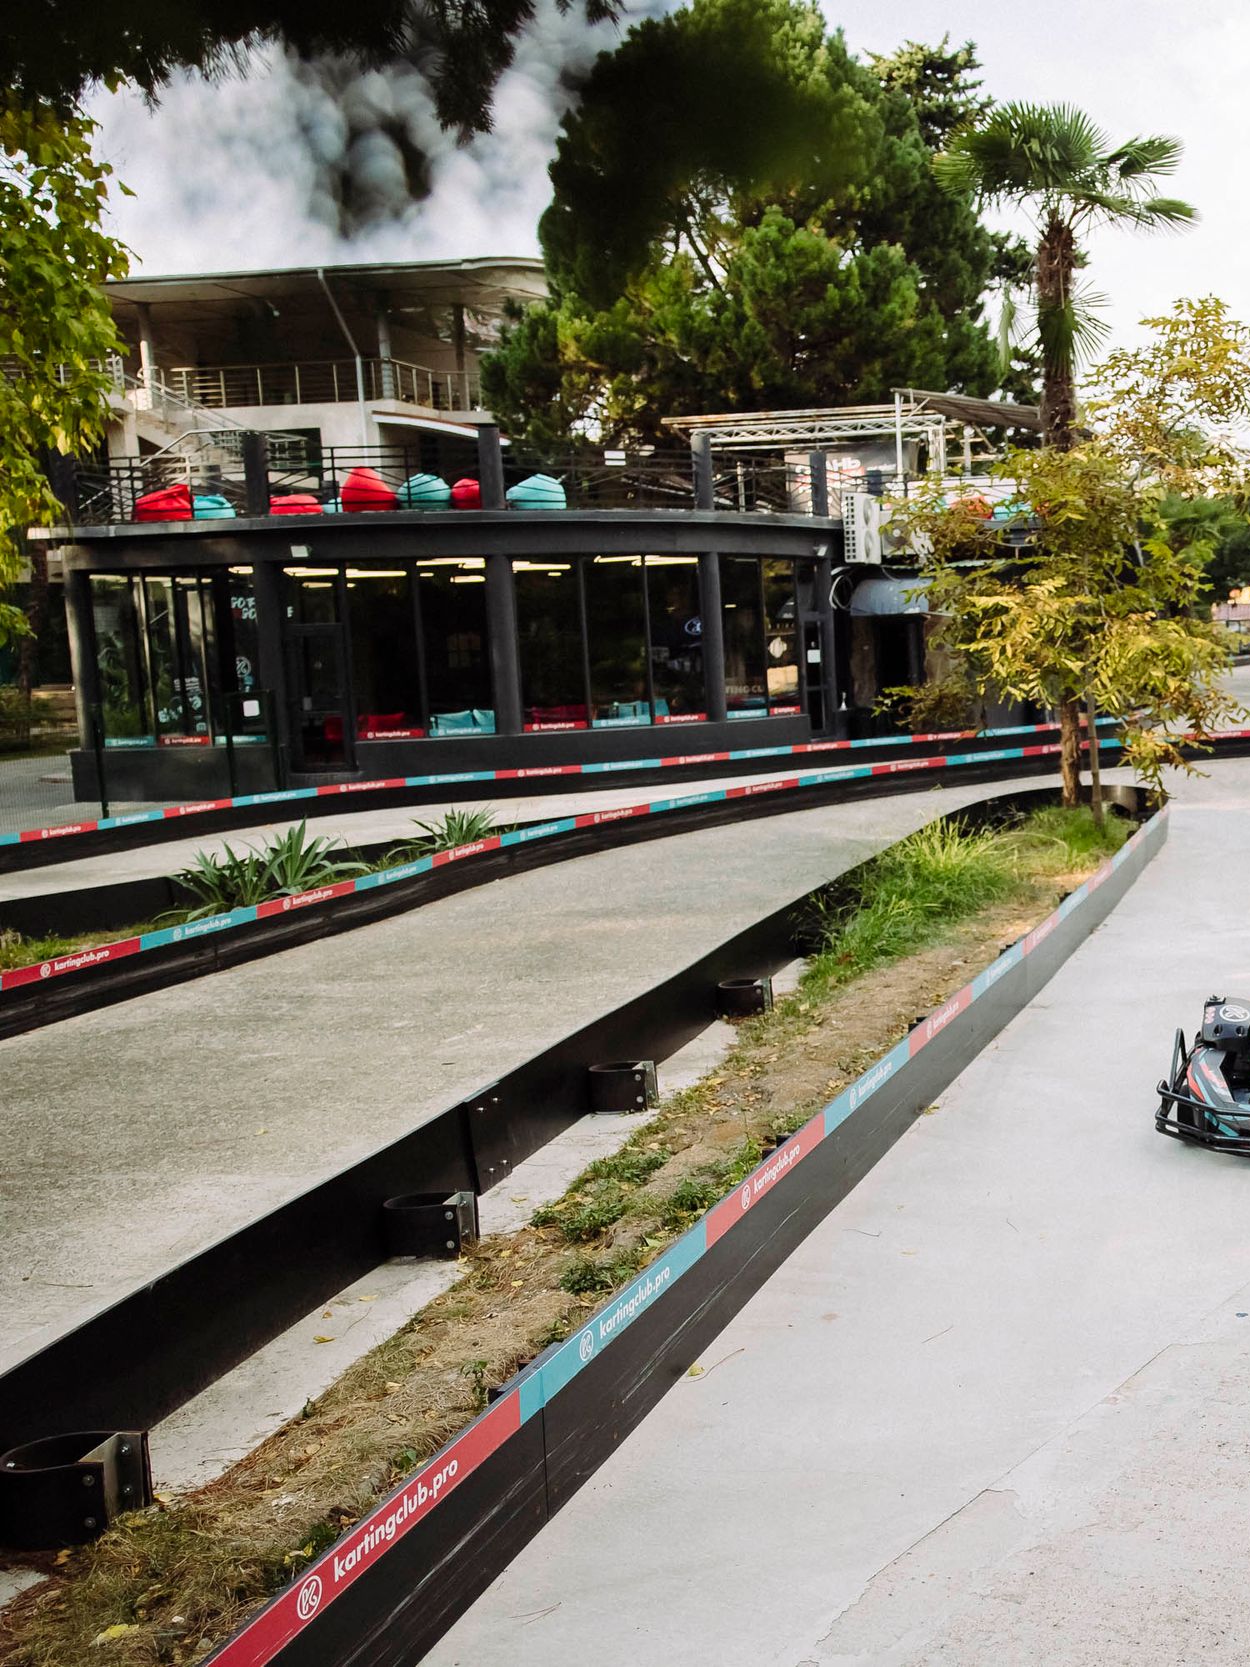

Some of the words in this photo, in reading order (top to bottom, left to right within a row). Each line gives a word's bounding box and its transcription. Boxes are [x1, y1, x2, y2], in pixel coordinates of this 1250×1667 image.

[184, 916, 232, 936] kartingclub.pro
[54, 949, 110, 971] kartingclub.pro
[752, 1143, 802, 1195] kartingclub.pro
[598, 1266, 671, 1340] kartingclub.pro
[332, 1458, 459, 1582] kartingclub.pro
